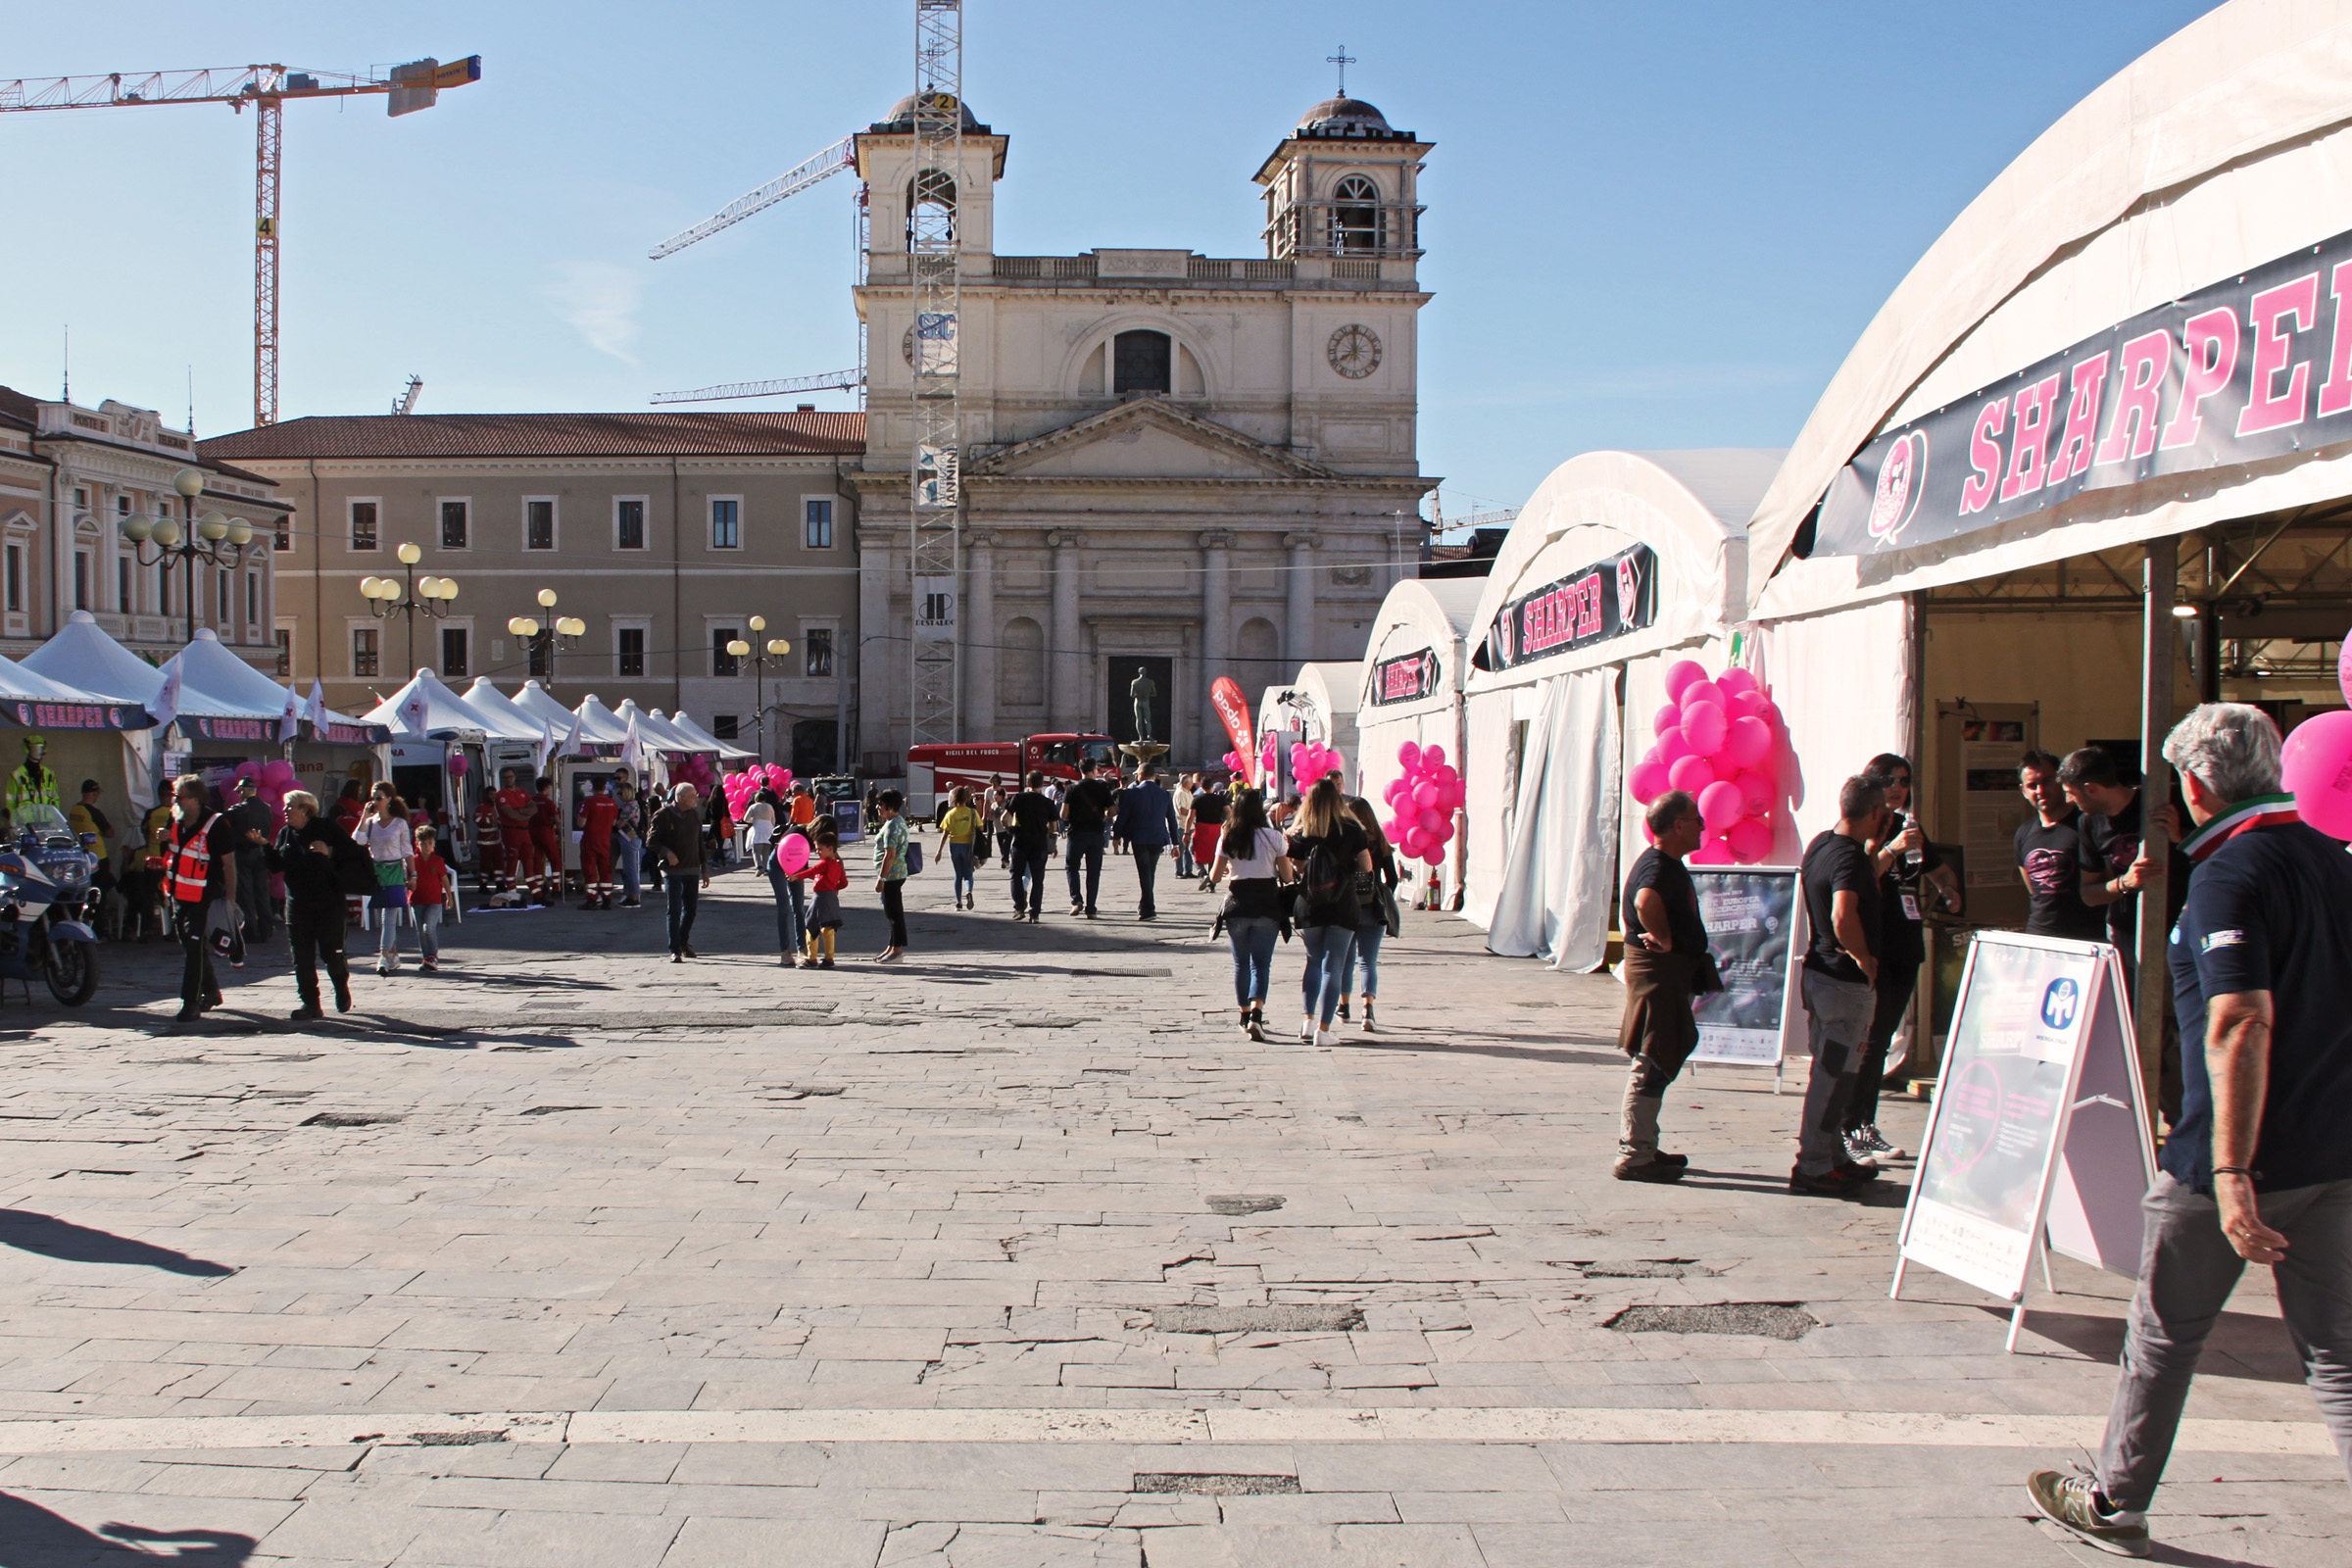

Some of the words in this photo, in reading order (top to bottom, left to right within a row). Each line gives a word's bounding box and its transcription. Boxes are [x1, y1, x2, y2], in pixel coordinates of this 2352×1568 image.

[939, 94, 949, 109] 2
[259, 219, 271, 235] 4
[947, 447, 958, 509] IANNINI
[1522, 571, 1602, 656] SHARPER
[35, 705, 106, 728] SHARPER
[213, 719, 262, 739] SHARPER
[294, 761, 324, 772] iana
[1705, 918, 1757, 933] HARPER
